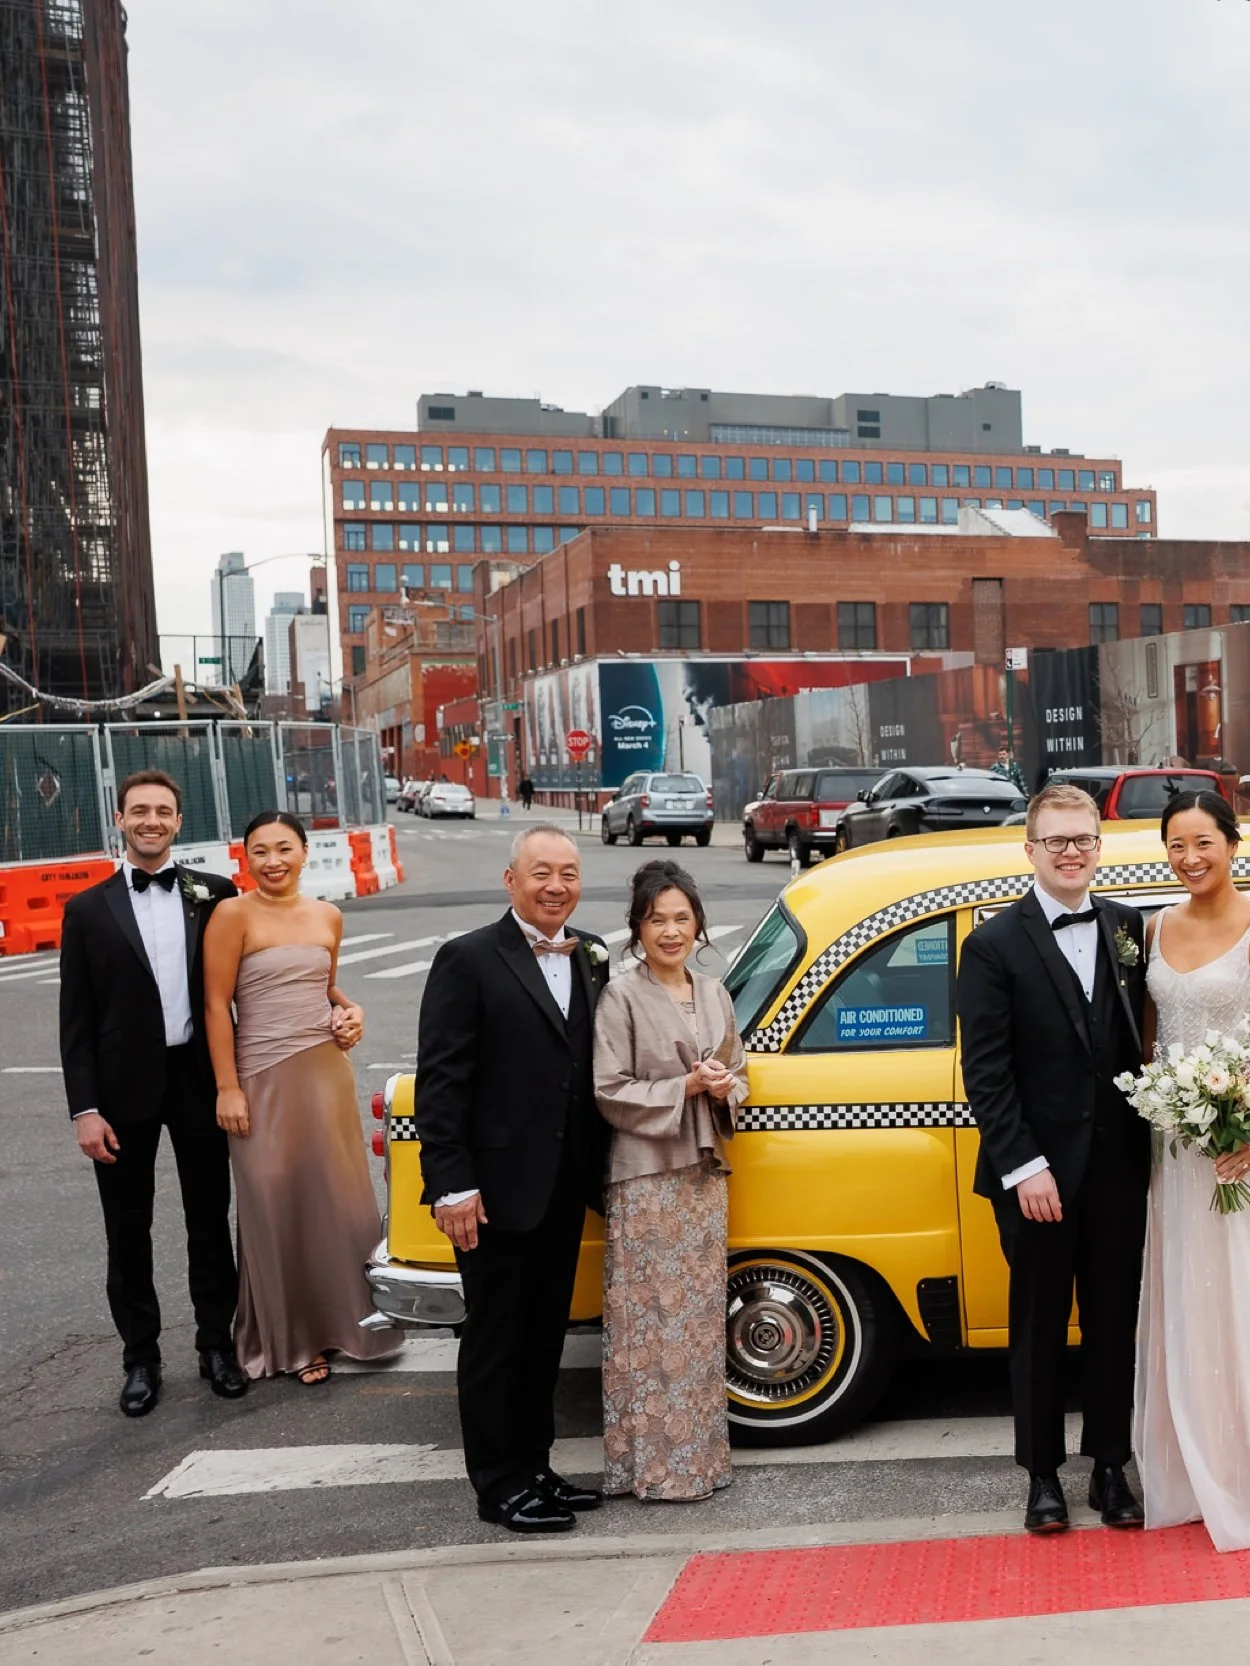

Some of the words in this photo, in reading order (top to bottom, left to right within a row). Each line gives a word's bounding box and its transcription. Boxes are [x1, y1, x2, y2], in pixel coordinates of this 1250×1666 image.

[608, 559, 681, 597] tmi
[1046, 706, 1083, 723] DESIGN
[568, 736, 589, 747] STOP
[1046, 736, 1084, 753] WITHIN
[840, 1011, 857, 1024] AIR
[859, 1008, 924, 1023] CONDITIONED
[840, 1028, 857, 1037] FOR
[859, 1027, 881, 1037] YOUR
[884, 1026, 924, 1036] COMFORT
